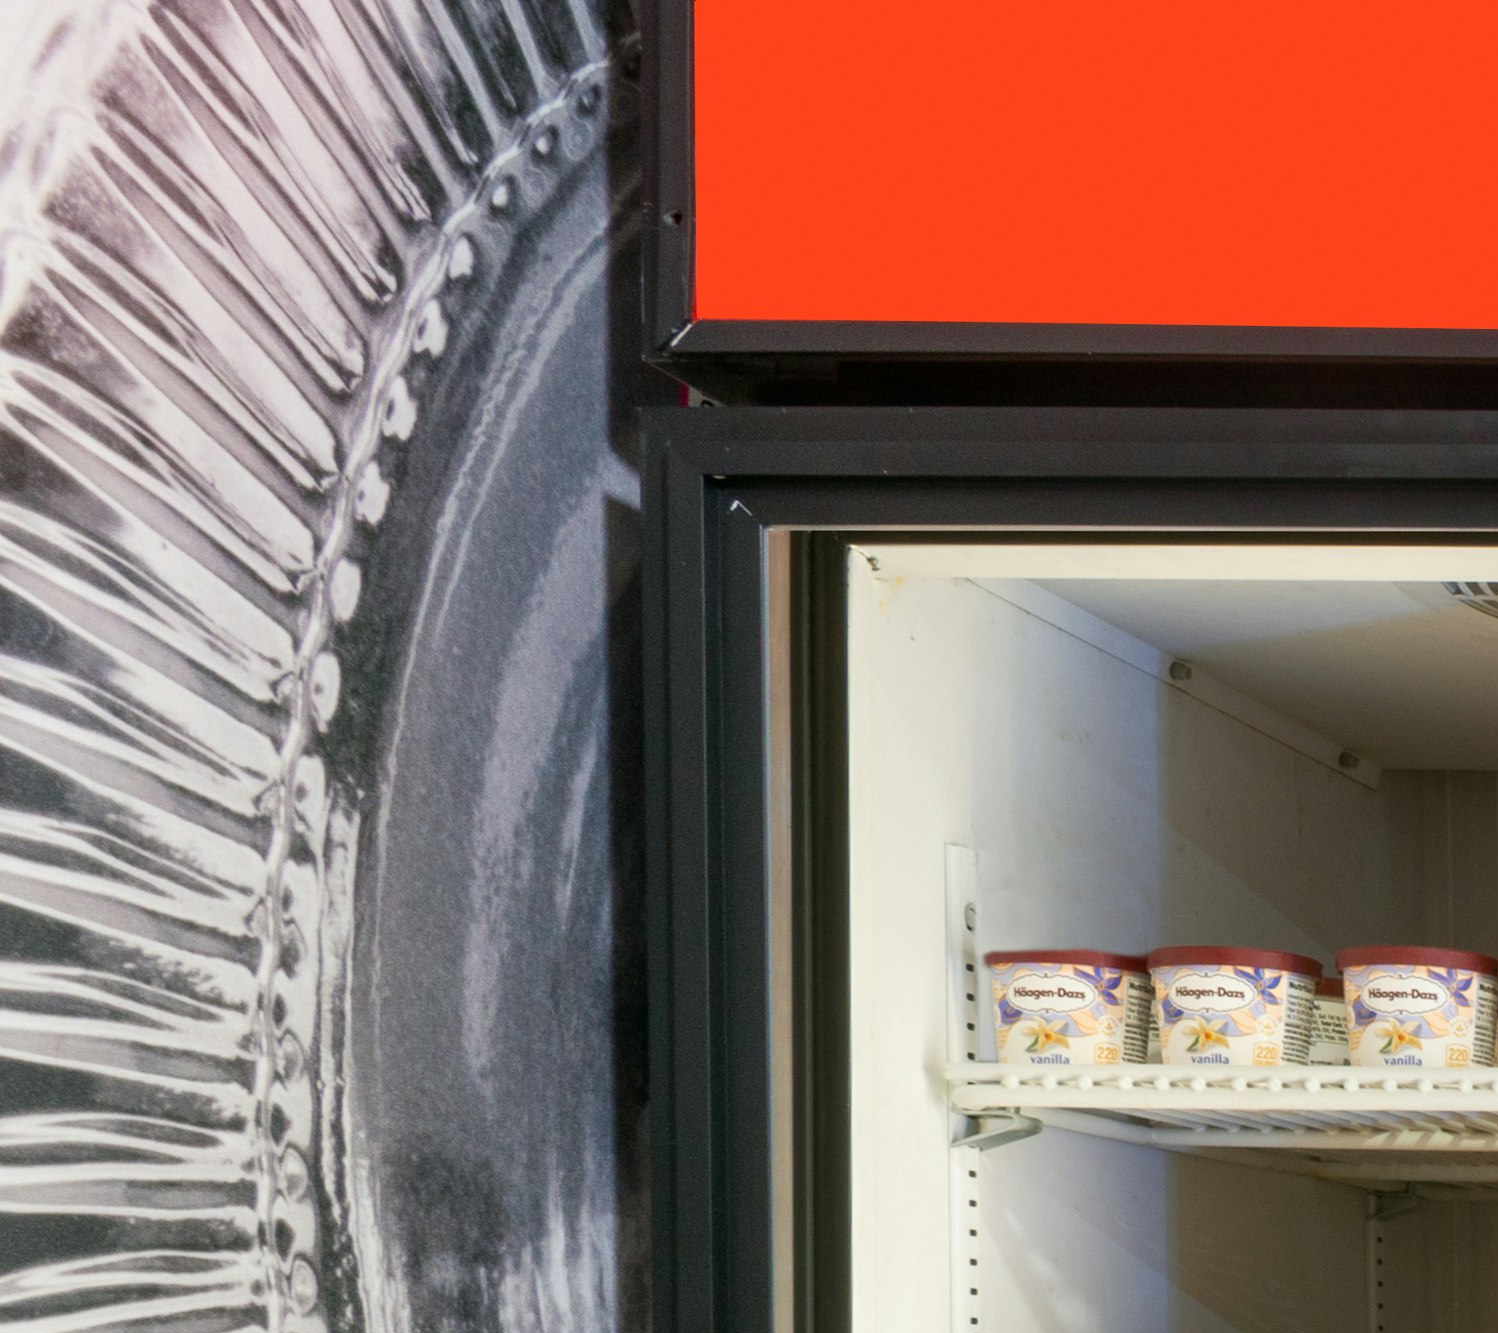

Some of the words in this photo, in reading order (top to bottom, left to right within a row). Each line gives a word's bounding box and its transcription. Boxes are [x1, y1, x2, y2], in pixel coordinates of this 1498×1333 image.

[1013, 987, 1086, 1002] Häagen-Dazs
[1368, 987, 1438, 1002] Häagen-Dazs
[1191, 1055, 1230, 1065] vanilla
